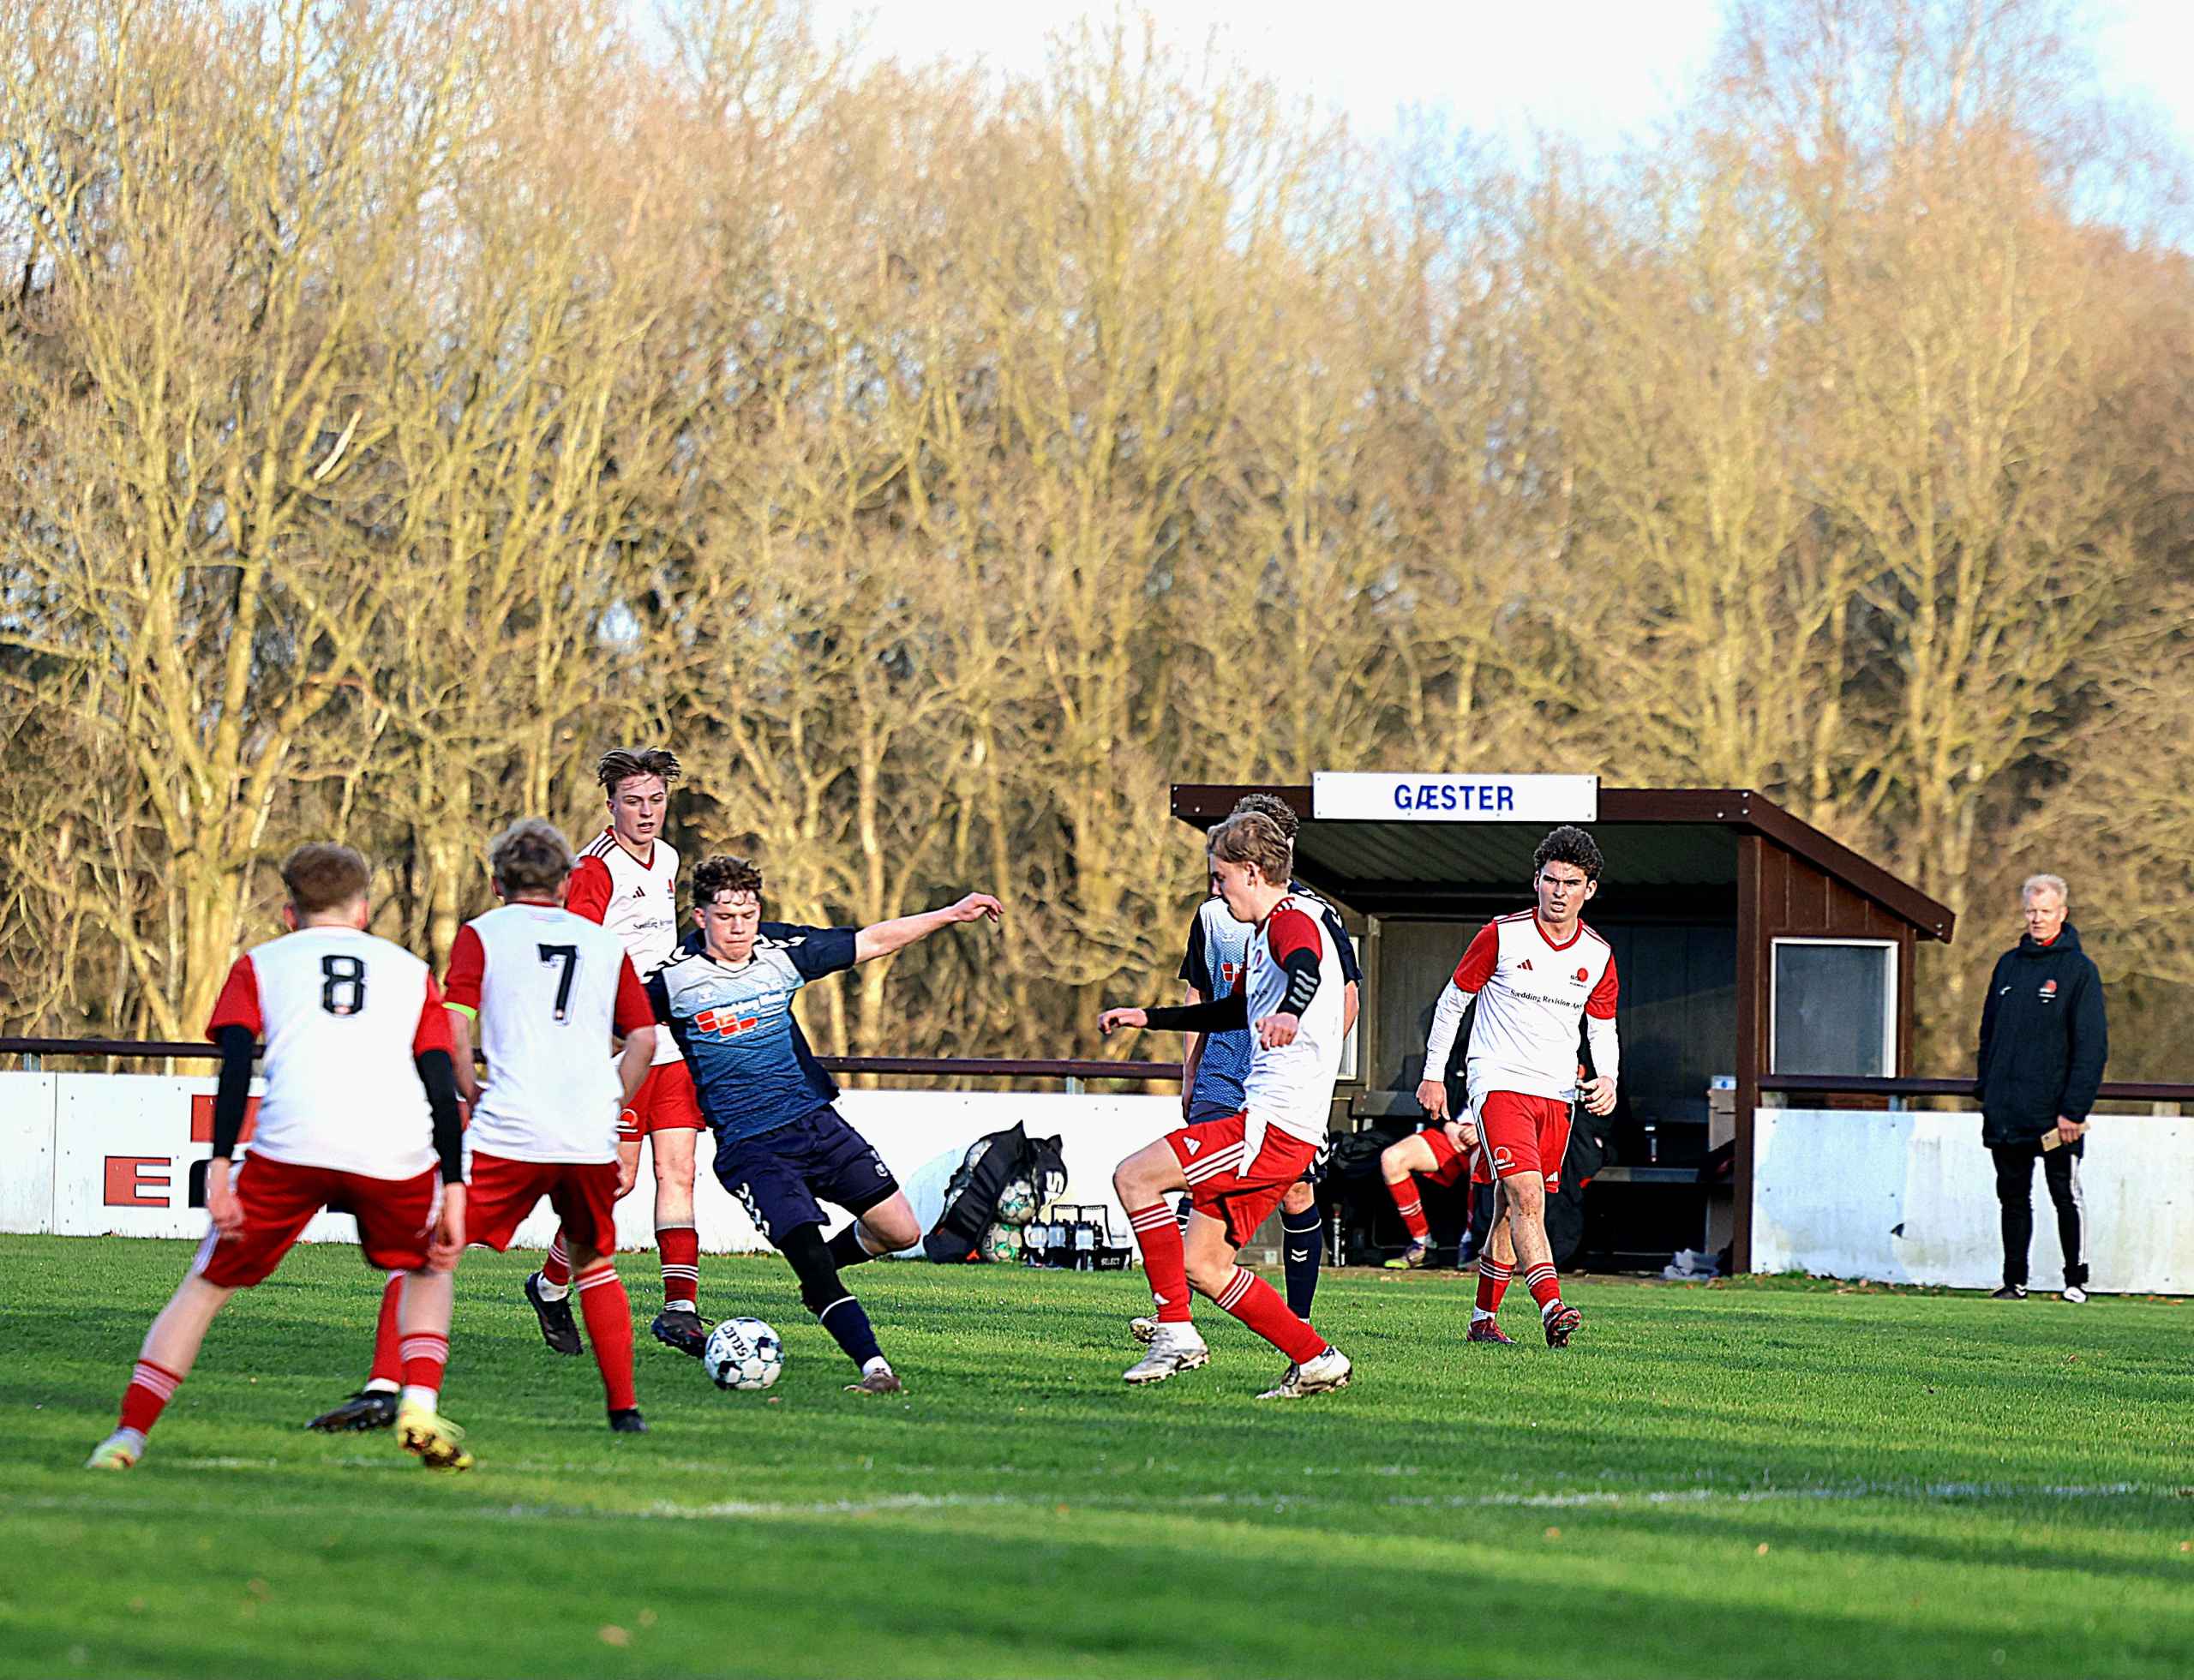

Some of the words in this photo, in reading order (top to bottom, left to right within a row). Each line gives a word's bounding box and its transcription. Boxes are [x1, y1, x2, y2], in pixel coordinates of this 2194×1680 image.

[1394, 784, 1514, 811] GÆSTER
[322, 954, 365, 1015] 8
[537, 943, 578, 1020] 7
